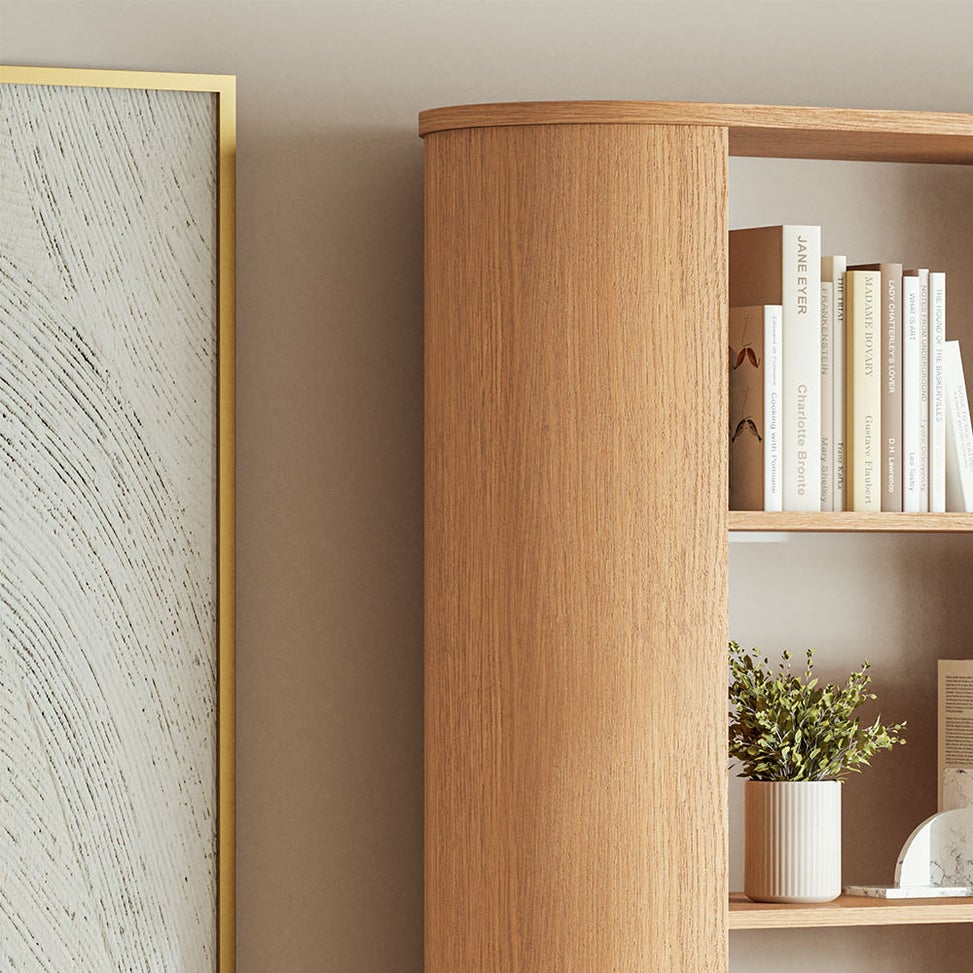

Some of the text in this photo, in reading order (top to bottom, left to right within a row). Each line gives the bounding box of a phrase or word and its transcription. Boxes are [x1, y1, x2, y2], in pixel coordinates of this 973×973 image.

[798, 235, 808, 314] JANE EYER
[935, 288, 943, 304] THE
[821, 288, 829, 375] FRANKENSTEIN
[864, 277, 873, 377] MADAME BOVARY
[888, 280, 896, 393] LADY CHATTERLEY'S LOVER
[909, 316, 916, 324] IS
[935, 305, 943, 333] HOUND
[935, 335, 943, 346] OF
[935, 349, 943, 363] THE
[770, 392, 778, 429] Cooking
[935, 365, 943, 423] BASKERVILLES
[770, 432, 778, 453] with
[797, 384, 808, 496] Charlotte Bronte
[864, 415, 873, 504] Gustave Flaubert
[820, 437, 829, 503] Mary Shelley
